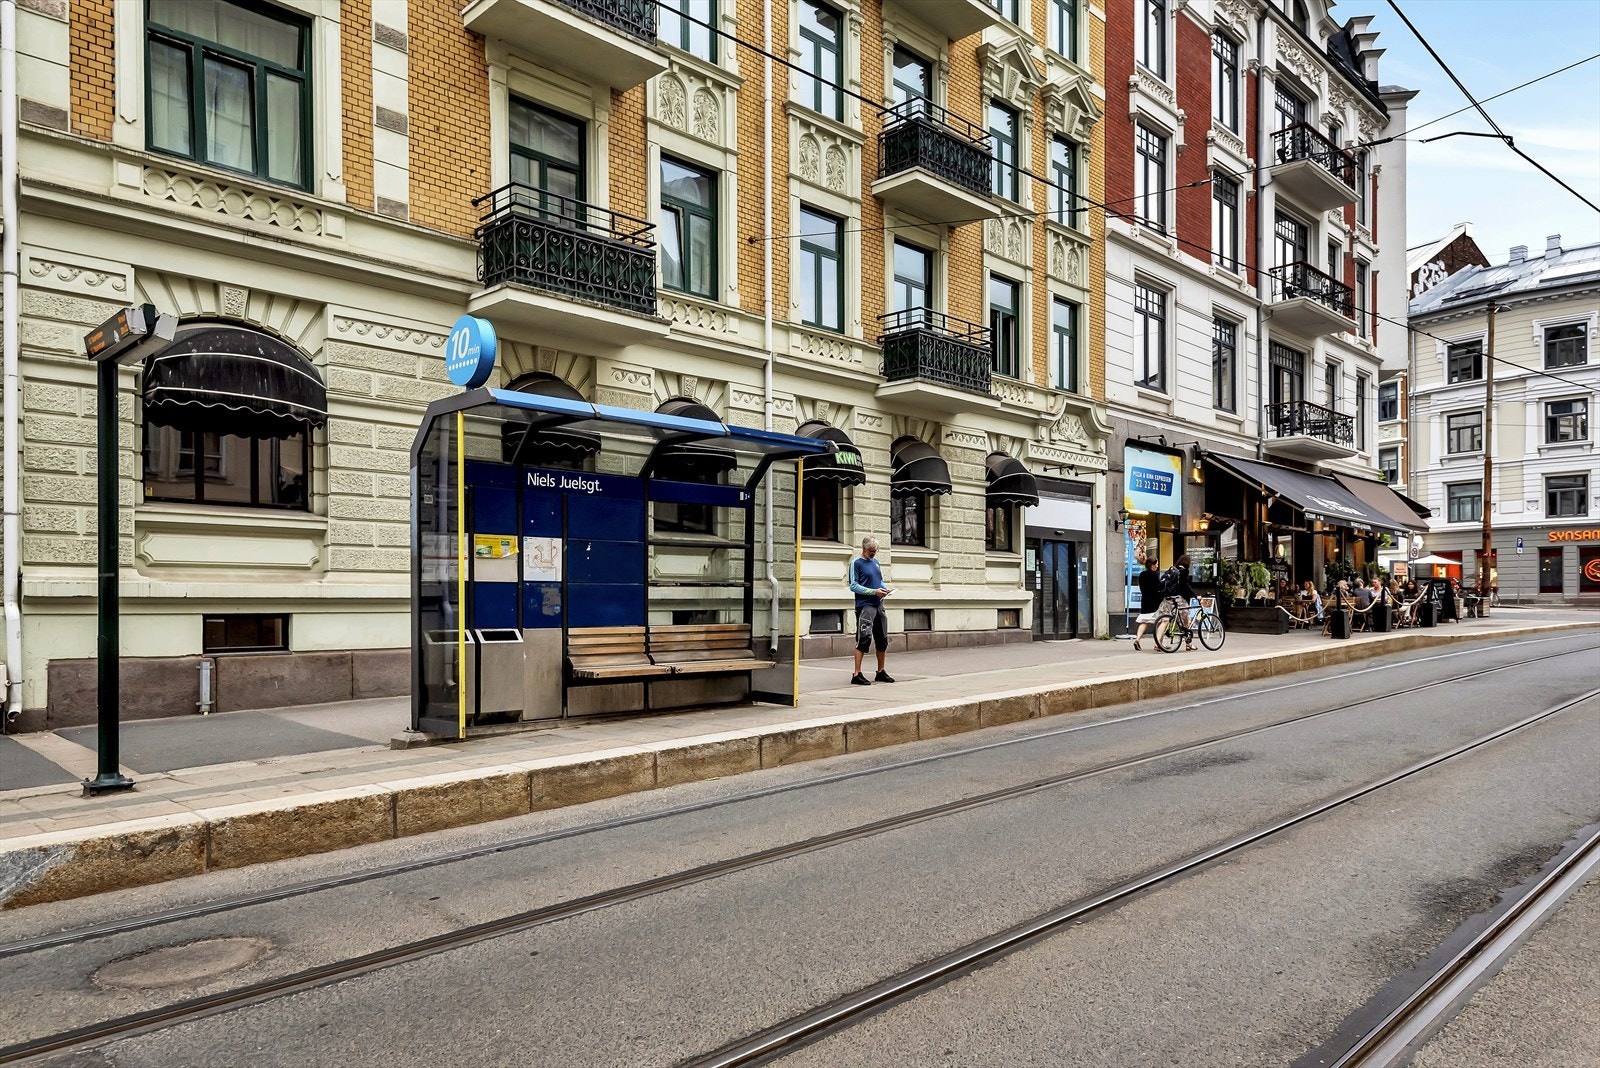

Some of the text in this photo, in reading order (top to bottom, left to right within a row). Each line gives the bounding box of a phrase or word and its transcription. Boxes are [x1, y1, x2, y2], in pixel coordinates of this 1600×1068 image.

[452, 327, 480, 361] 10 min
[835, 451, 858, 466] KIWI
[527, 473, 602, 494] Niels Juelsgt.
[1136, 479, 1166, 492] 22 22 22 22
